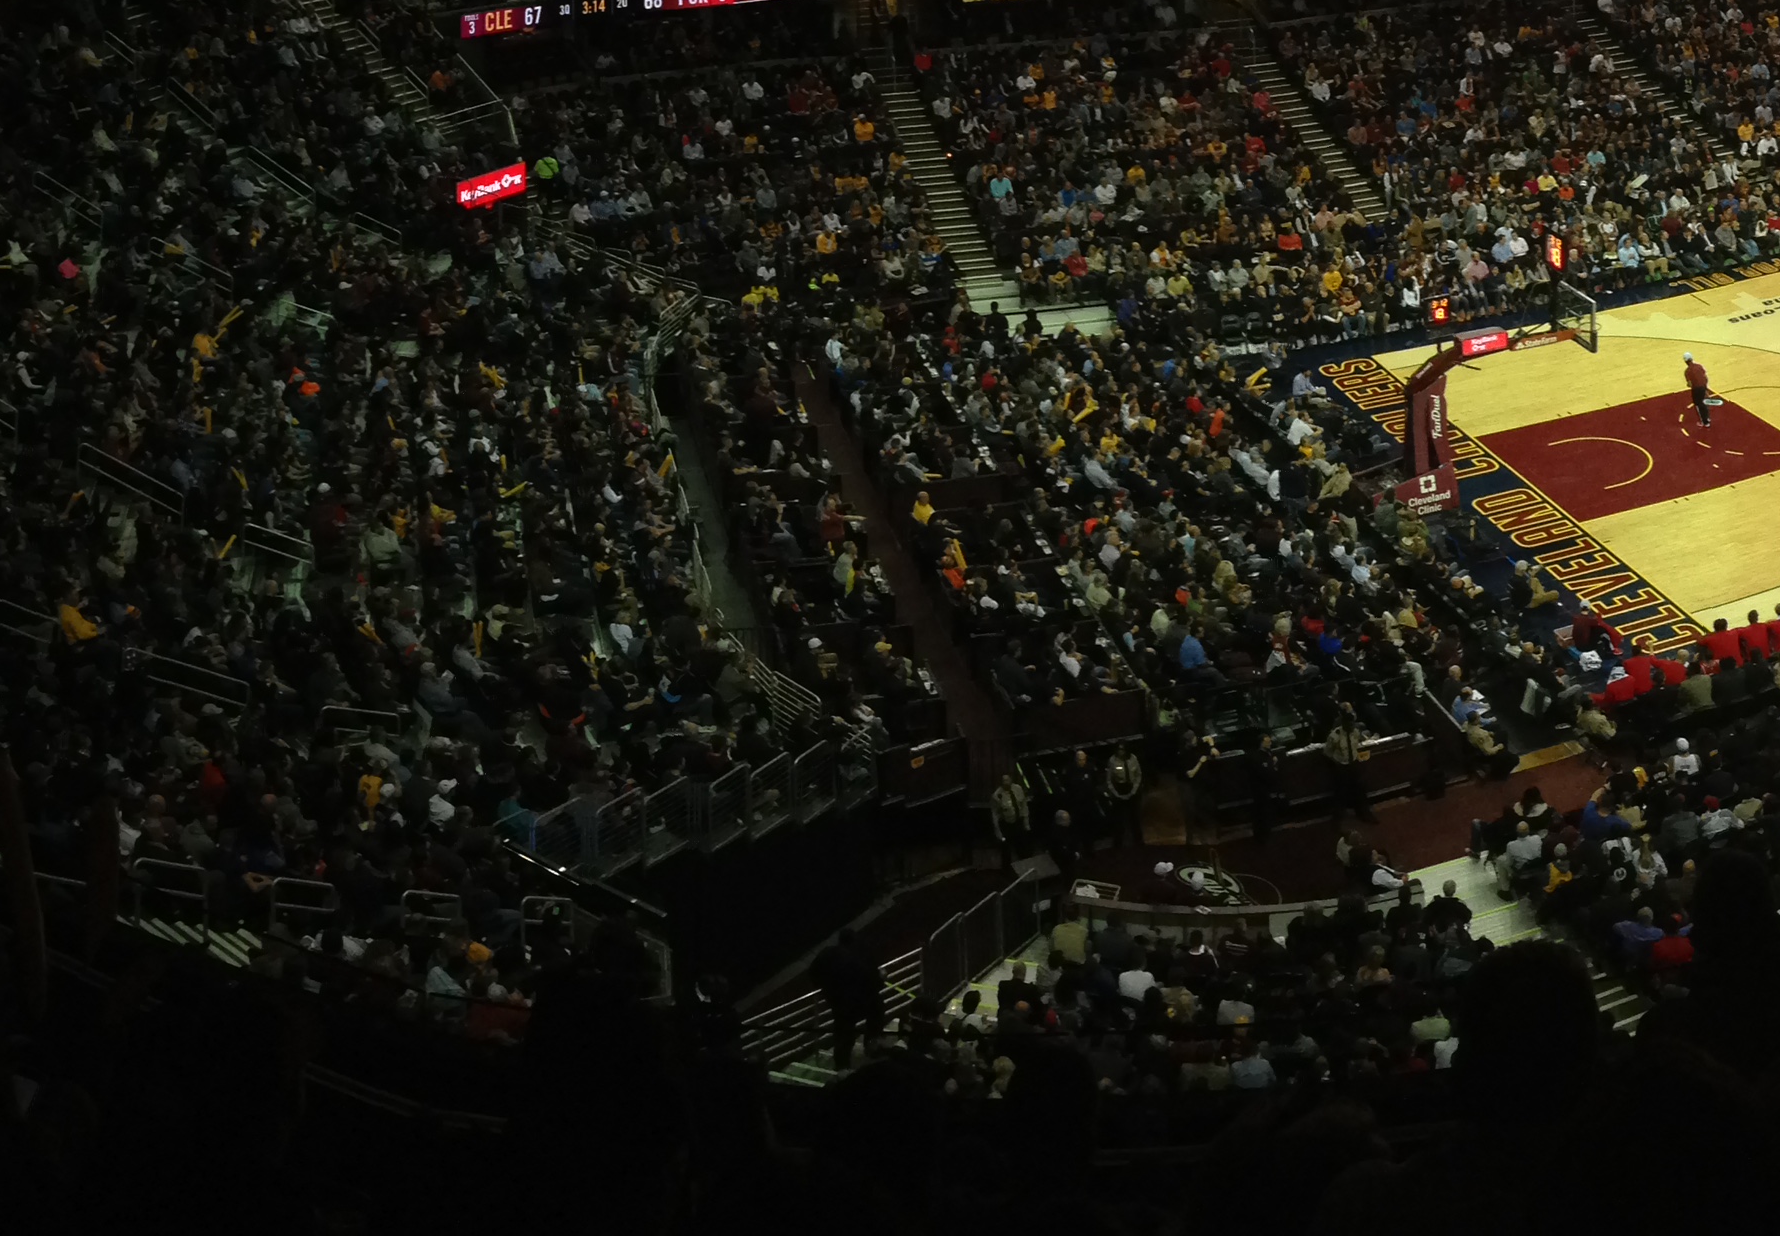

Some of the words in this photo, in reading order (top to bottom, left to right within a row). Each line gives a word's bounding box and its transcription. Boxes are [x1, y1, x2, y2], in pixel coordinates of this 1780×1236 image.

[484, 9, 513, 32] CLE
[524, 5, 542, 27] 67
[1430, 394, 1441, 440] FanDuel
[1408, 489, 1452, 508] Cleveland
[1417, 503, 1443, 516] Clinic
[1472, 487, 1710, 656] CLEVELAND
